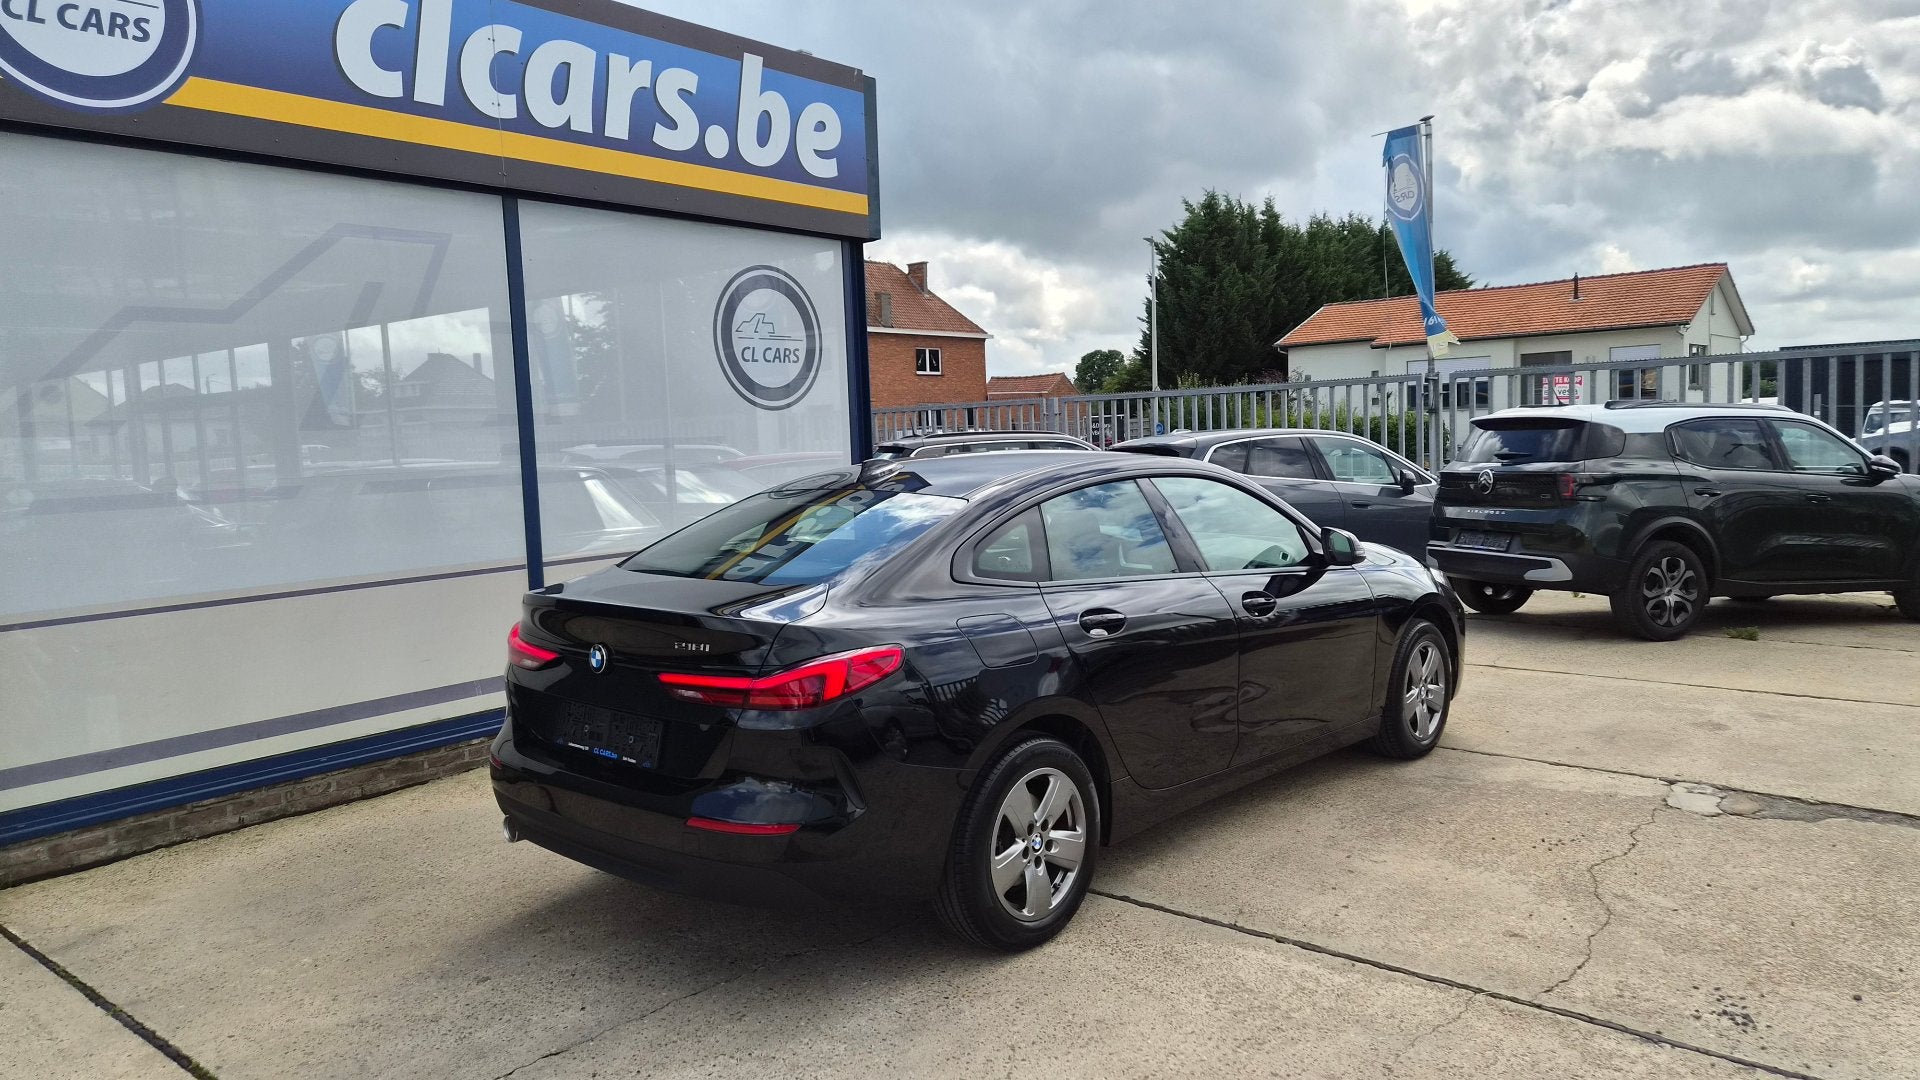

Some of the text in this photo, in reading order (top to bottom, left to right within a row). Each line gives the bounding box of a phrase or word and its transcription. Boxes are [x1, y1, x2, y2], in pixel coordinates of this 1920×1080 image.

[1, 0, 151, 43] CL CARS
[335, 0, 842, 179] clcars.be
[741, 346, 800, 364] CL CARS
